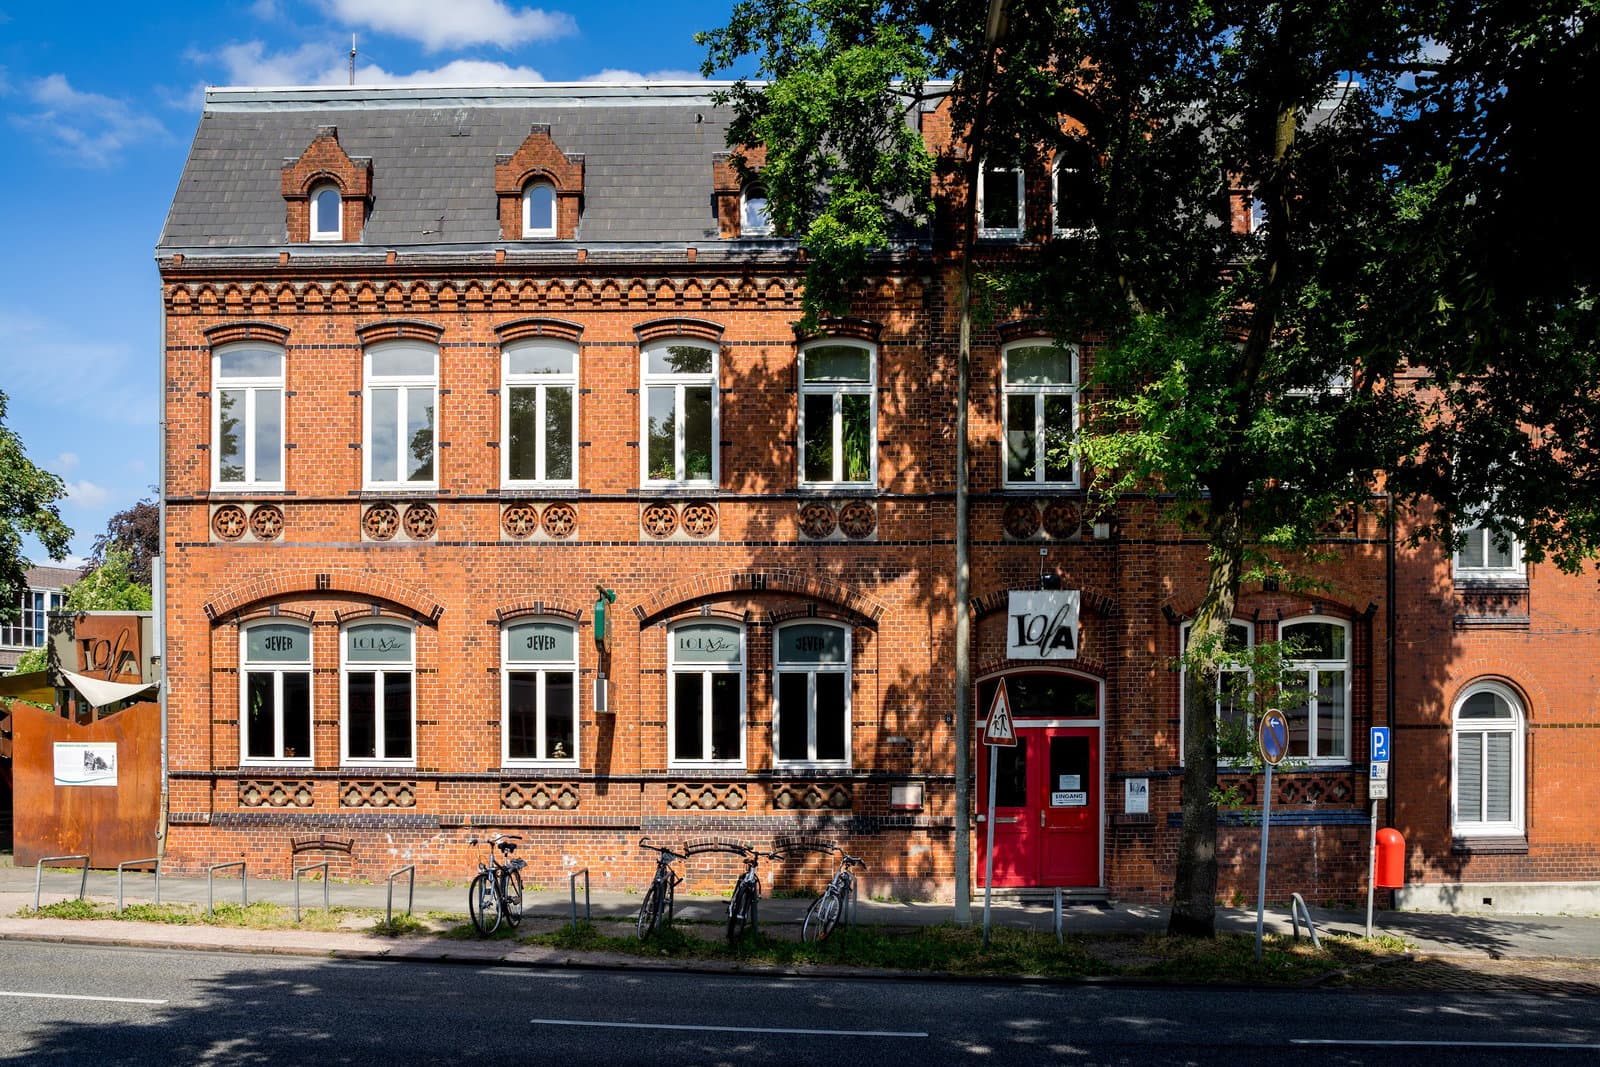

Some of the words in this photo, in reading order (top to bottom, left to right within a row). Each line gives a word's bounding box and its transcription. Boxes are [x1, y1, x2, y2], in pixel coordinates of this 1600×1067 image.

[265, 635, 293, 651] JEVER
[526, 634, 556, 651] JEVER
[795, 635, 825, 652] JEVER
[1374, 731, 1384, 758] P
